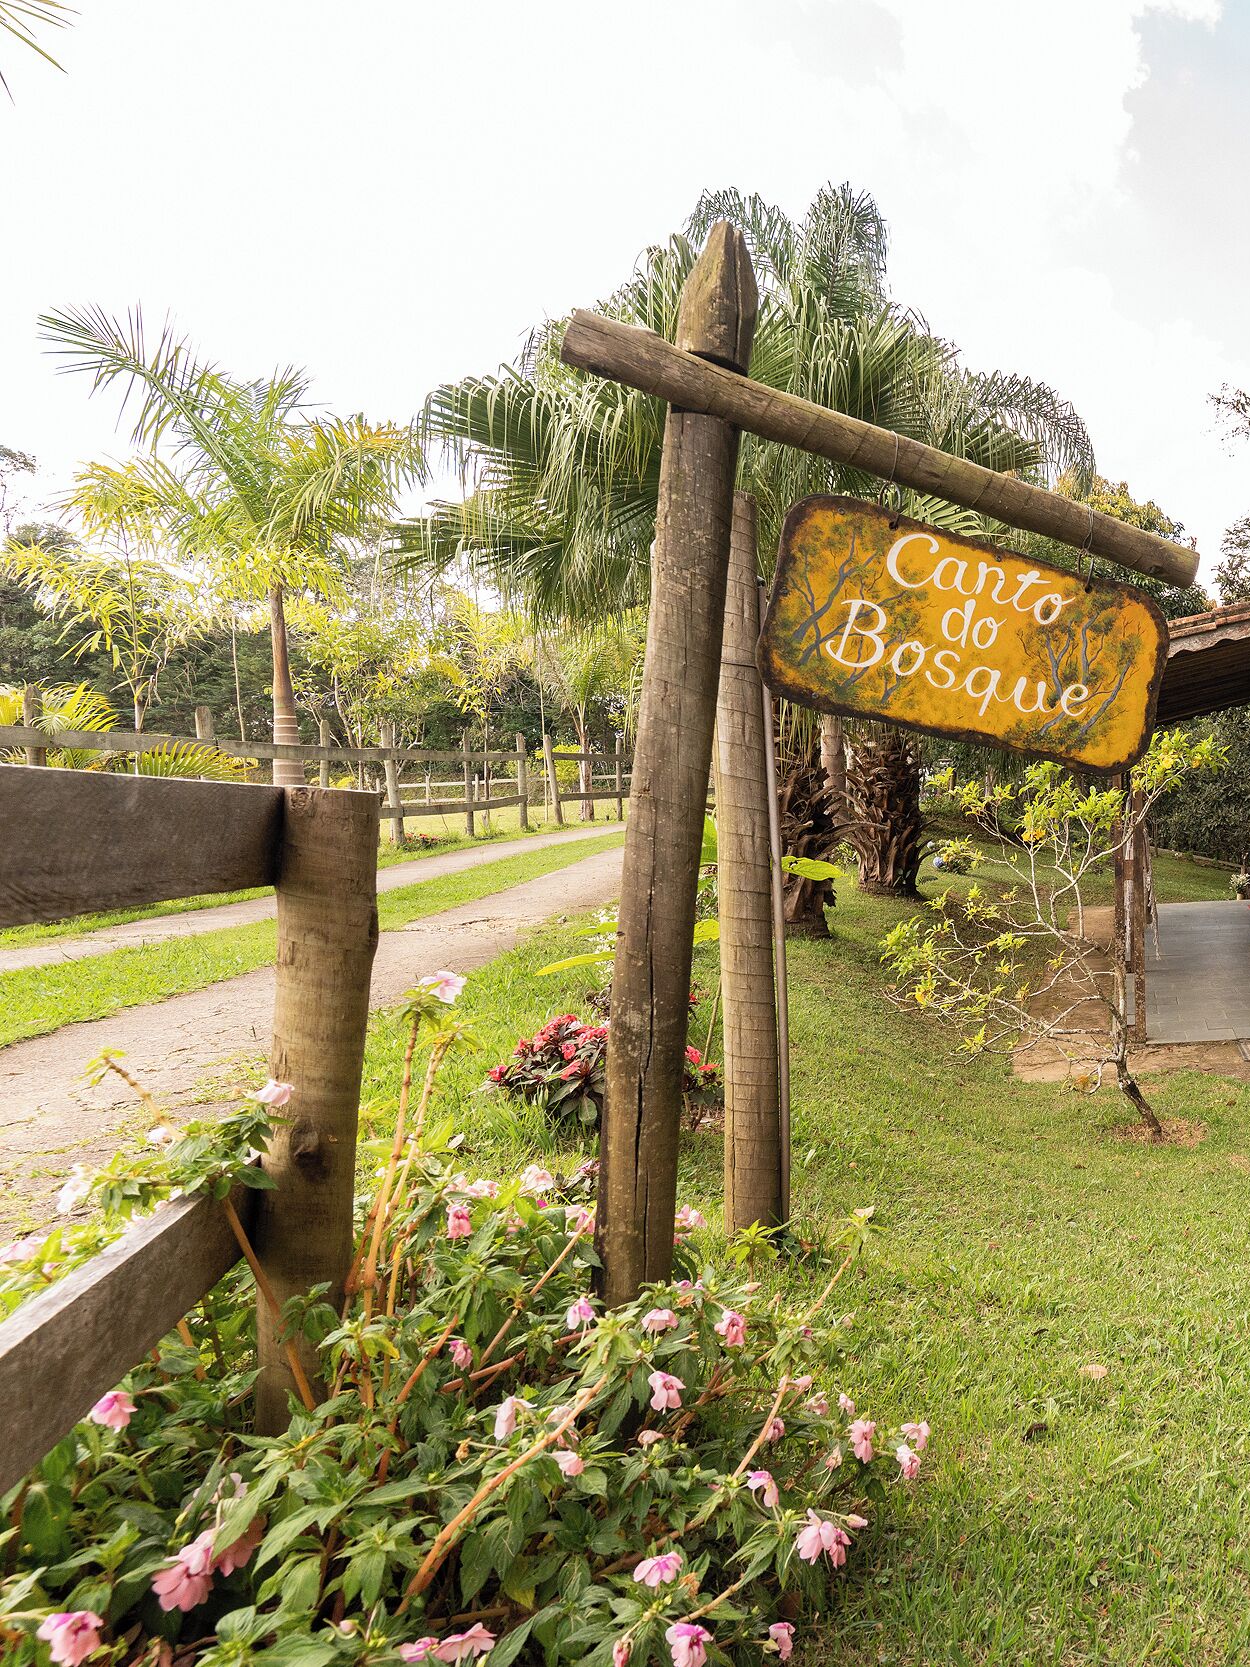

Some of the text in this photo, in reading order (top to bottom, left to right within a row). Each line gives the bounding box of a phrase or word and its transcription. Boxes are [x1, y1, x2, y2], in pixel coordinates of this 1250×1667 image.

[887, 534, 1075, 625] Canto
[942, 600, 1007, 649] do
[826, 601, 1089, 716] Bosque
